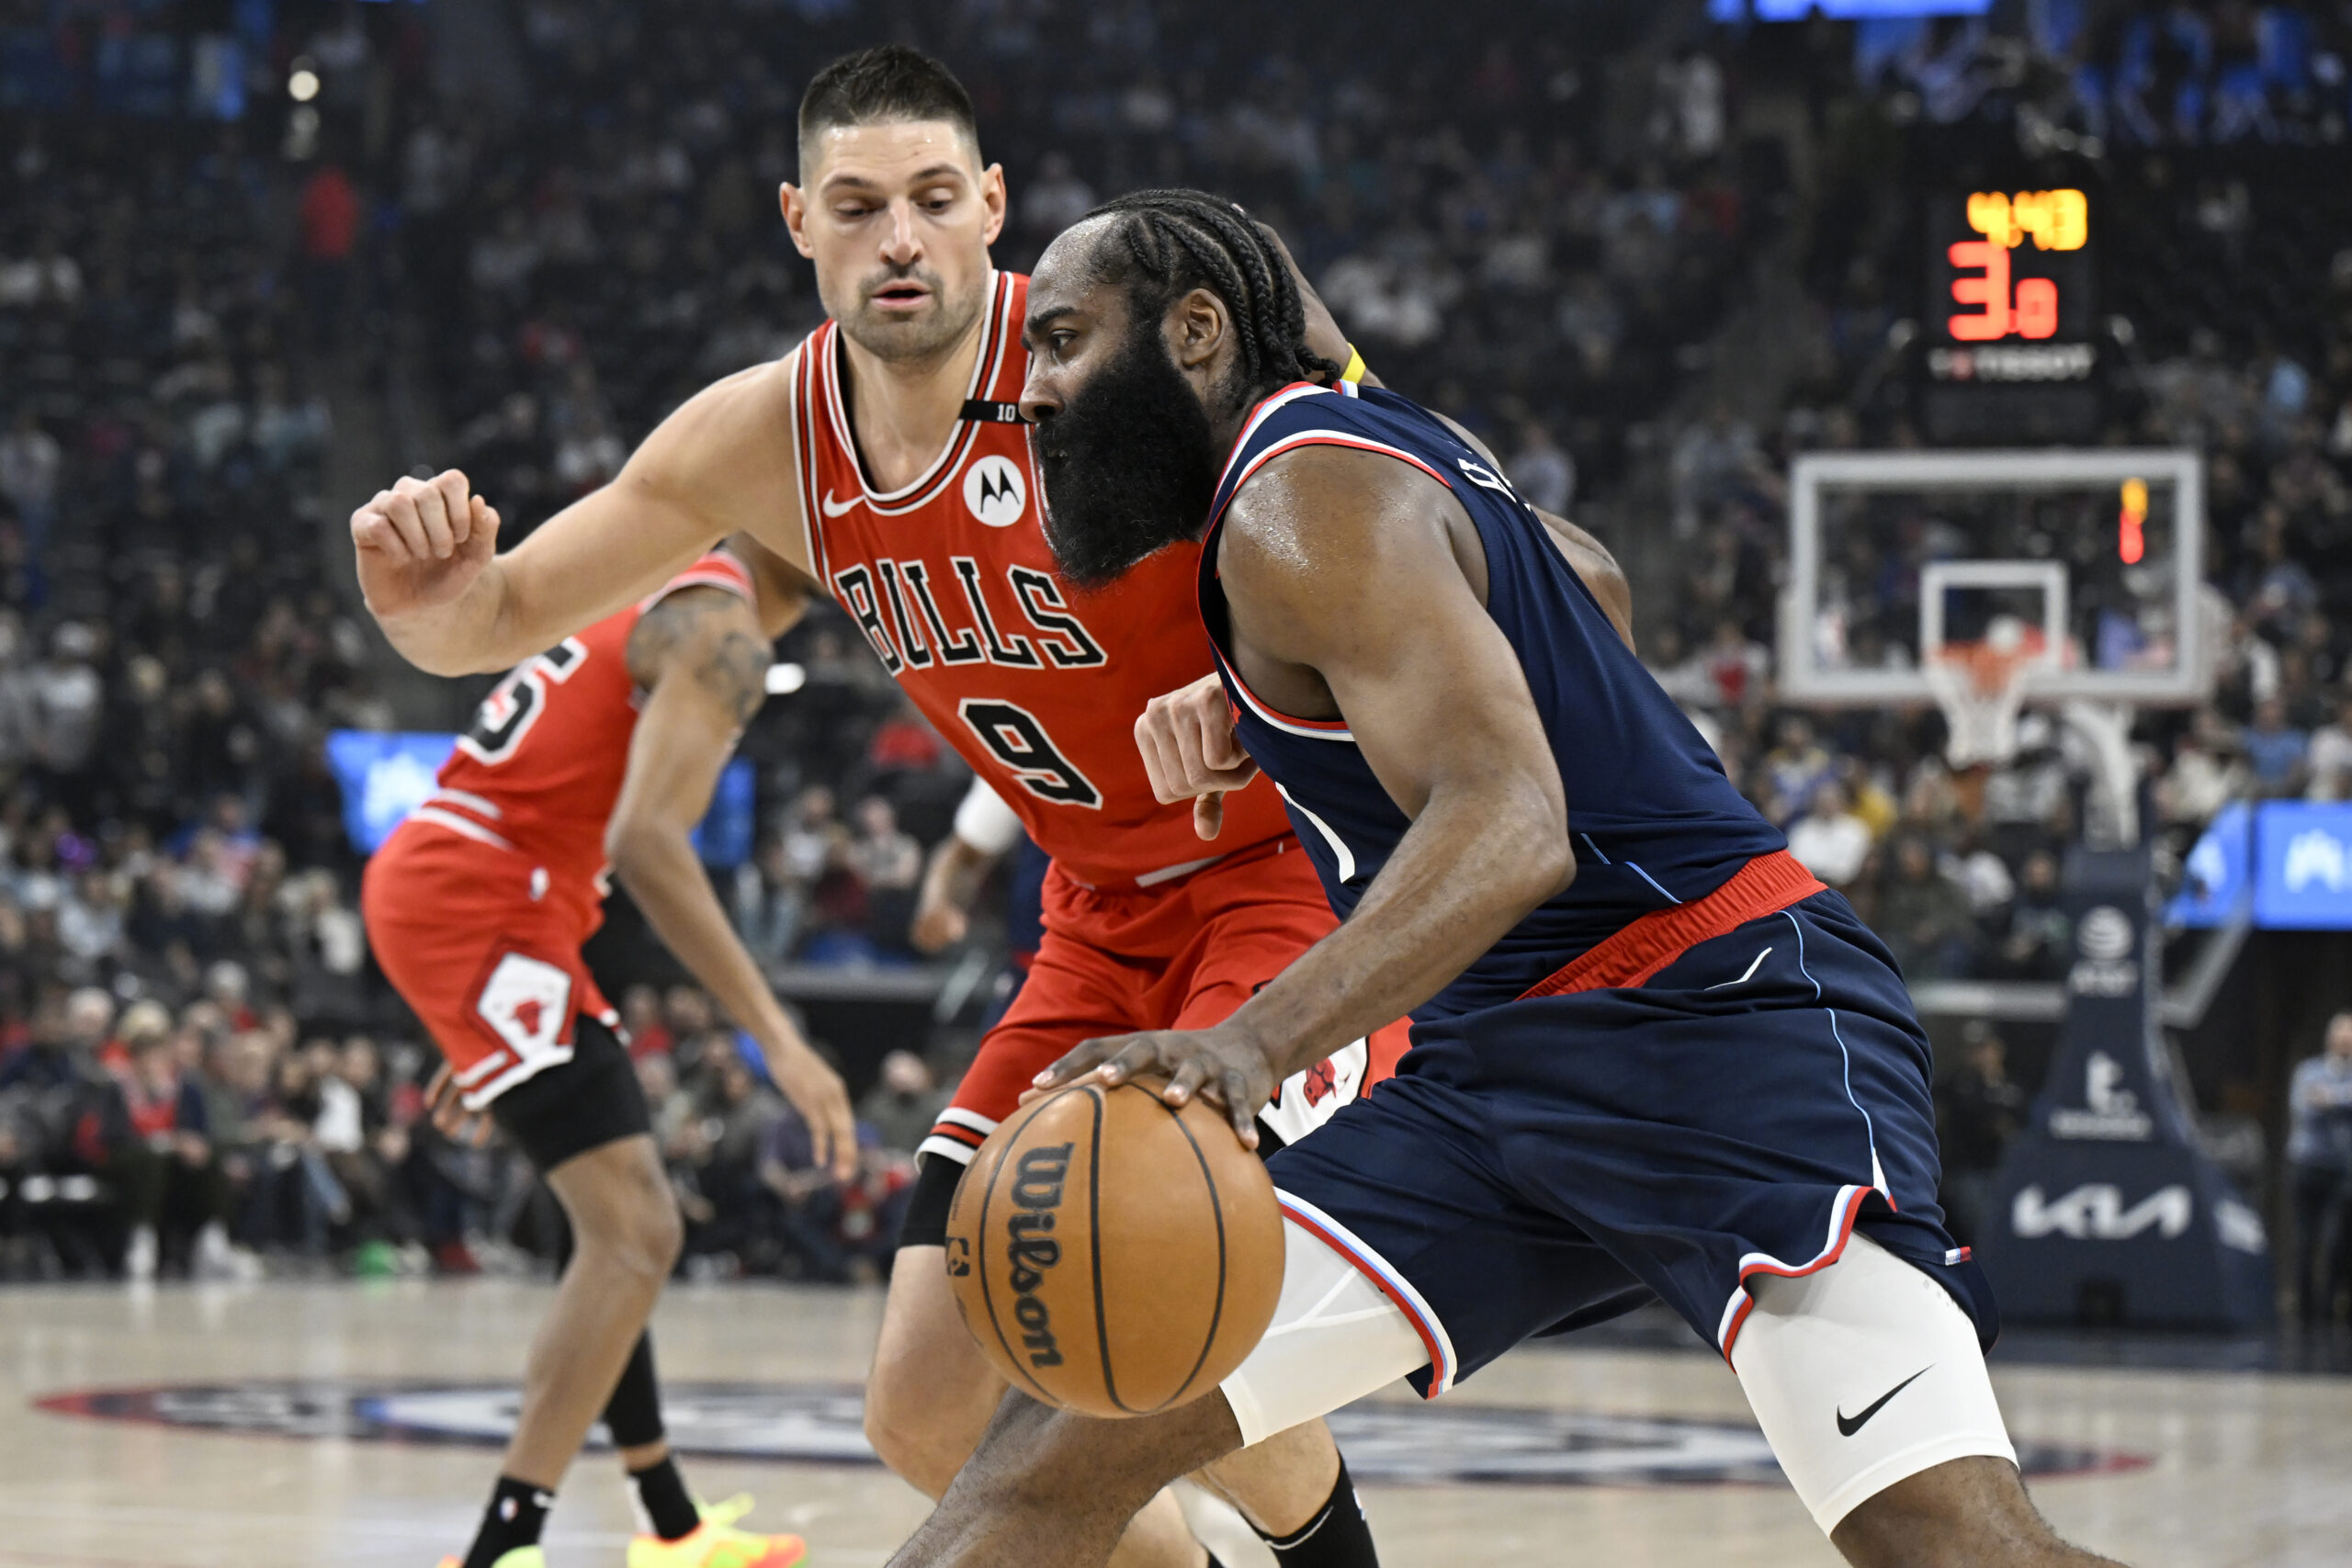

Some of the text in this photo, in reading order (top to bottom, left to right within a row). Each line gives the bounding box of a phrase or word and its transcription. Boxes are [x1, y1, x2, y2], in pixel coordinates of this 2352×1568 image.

[997, 403, 1016, 423] 10
[833, 556, 1109, 677] BULLS
[957, 697, 1103, 811] 9
[1007, 1141, 1075, 1369] Wilson
